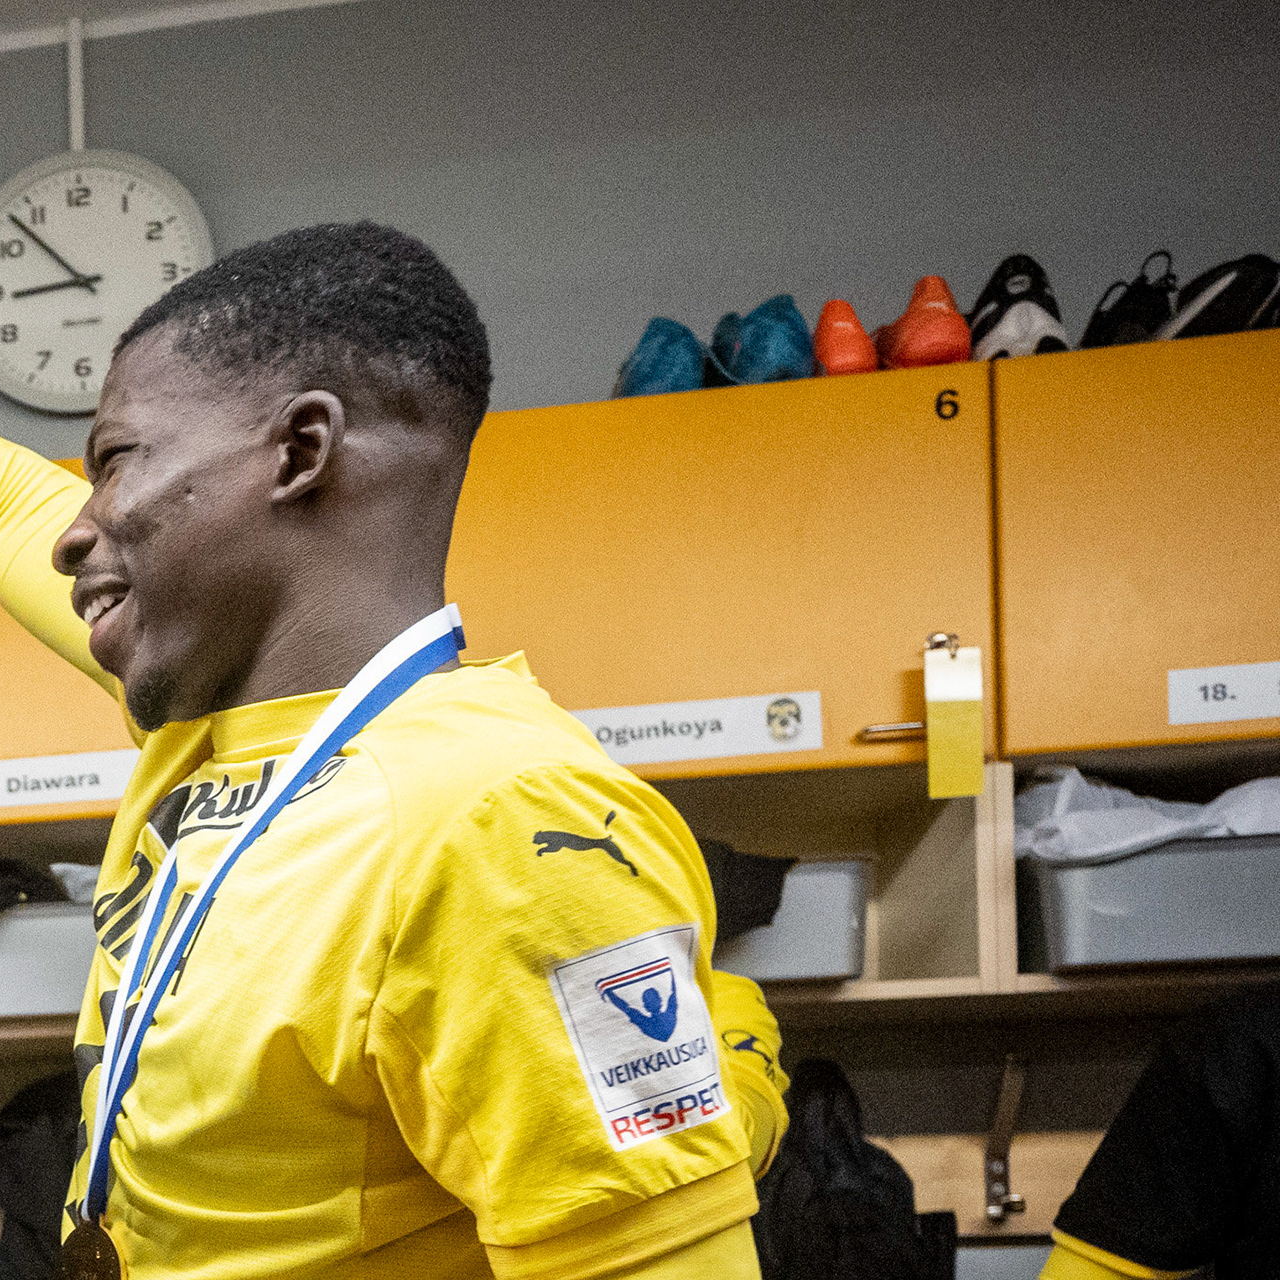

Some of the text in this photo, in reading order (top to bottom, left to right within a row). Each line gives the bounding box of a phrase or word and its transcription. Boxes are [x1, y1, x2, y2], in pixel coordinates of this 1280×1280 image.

[66, 187, 92, 207] 12
[120, 194, 129, 214] 1
[30, 205, 47, 224] 11
[145, 220, 163, 241] 2
[0, 238, 25, 259] 10
[161, 261, 178, 282] 3
[0, 323, 19, 344] 8
[36, 350, 53, 370] 7
[73, 357, 92, 377] 6
[934, 388, 960, 421] 6
[1198, 682, 1236, 702] 18.
[595, 718, 722, 746] Ogunkoya
[6, 771, 100, 793] Diawara
